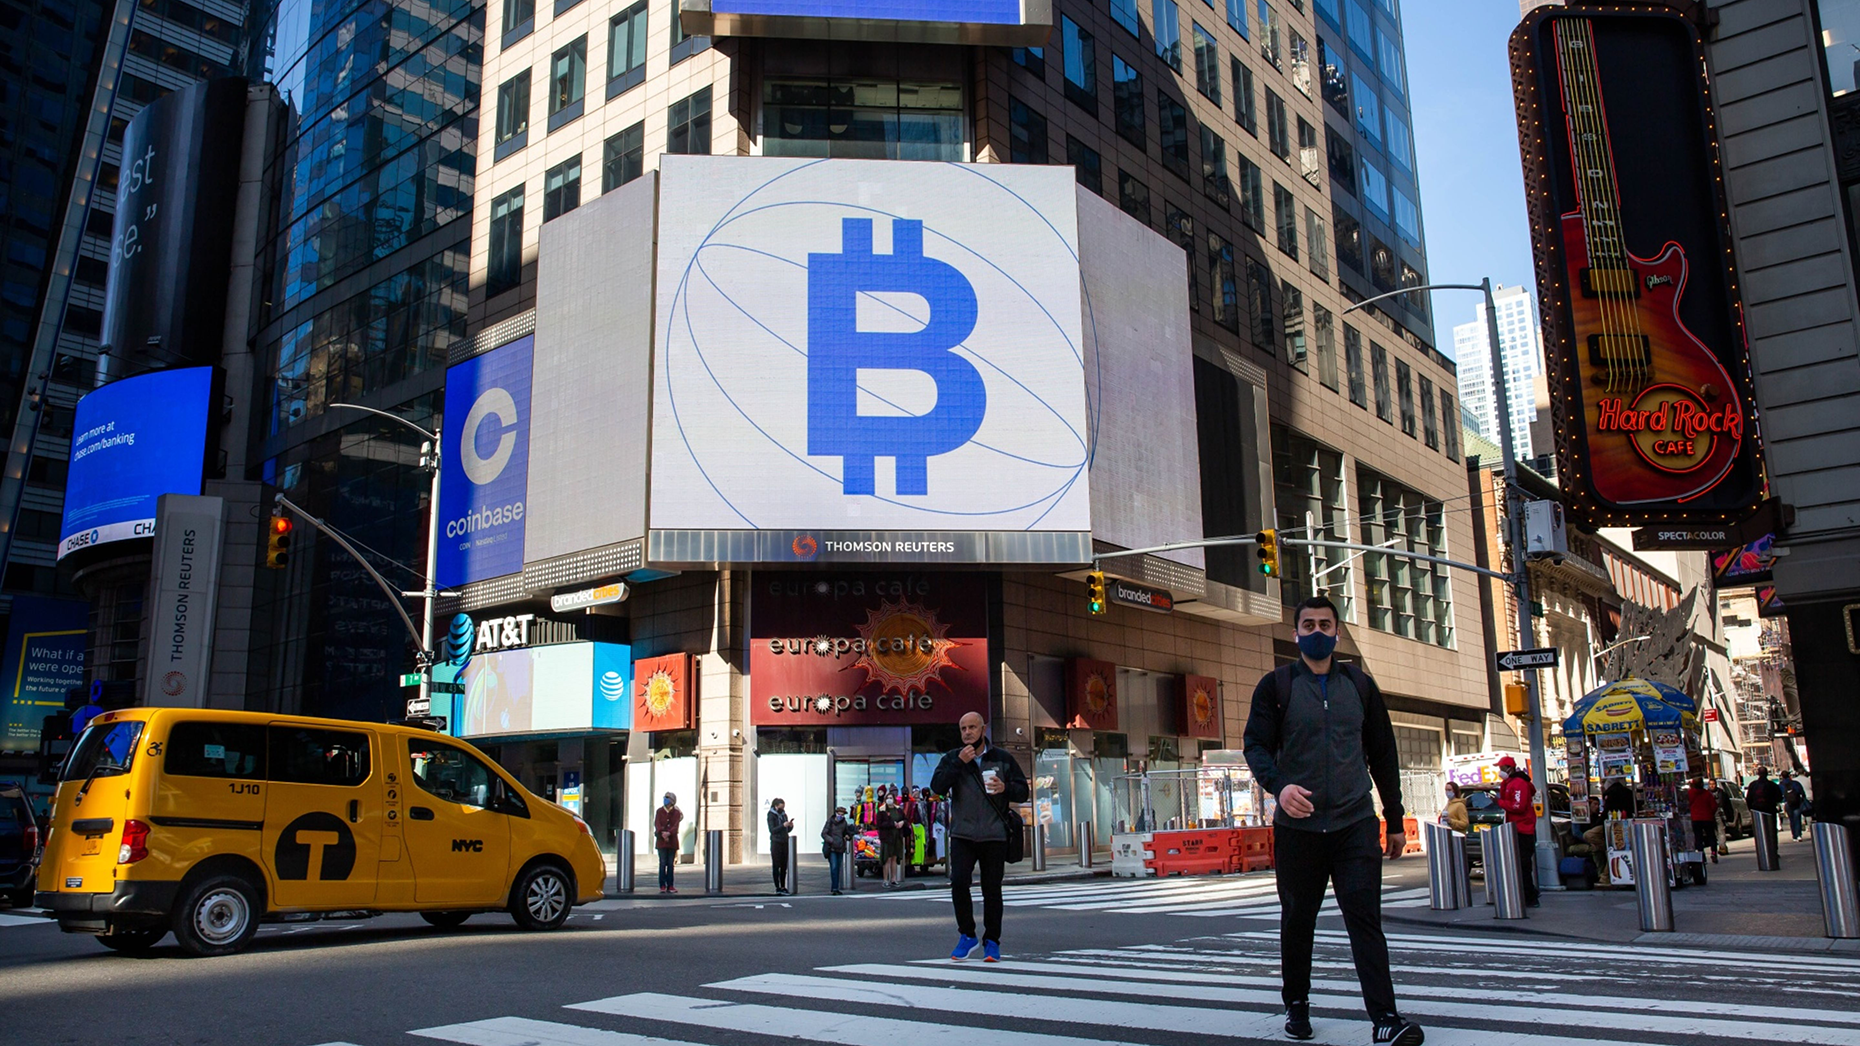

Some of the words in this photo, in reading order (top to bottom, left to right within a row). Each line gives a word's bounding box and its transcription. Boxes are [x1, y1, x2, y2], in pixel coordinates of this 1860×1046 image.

[1599, 398, 1669, 431] Hard
[1673, 399, 1742, 440] Rock
[76, 429, 89, 446] Learn
[88, 424, 106, 439] more
[106, 421, 115, 432] at
[74, 432, 136, 462] chase.com/banking
[1654, 440, 1695, 455] CAFE
[446, 501, 524, 538] coinbase
[67, 532, 90, 550] CHASE
[1658, 531, 1726, 541] SPECTACOLOR
[825, 541, 892, 552] THOMSON
[895, 541, 955, 553] REUTERS
[178, 529, 196, 590] REUTERS
[171, 594, 189, 662] THOMSON
[476, 613, 535, 650] AT&T
[769, 634, 867, 659] europa
[876, 631, 933, 653] café
[31, 647, 62, 660] What
[65, 649, 74, 660] if
[1505, 656, 1523, 665] ONE
[1530, 654, 1550, 663] WAY
[29, 662, 59, 672] were
[27, 676, 54, 685] Working
[38, 685, 59, 693] future
[768, 692, 867, 718] europa
[876, 689, 933, 710] café
[1595, 700, 1632, 712] SABRETT
[1586, 720, 1640, 732] SABRETT
[228, 783, 260, 795] 1J10
[452, 839, 483, 852] NYC
